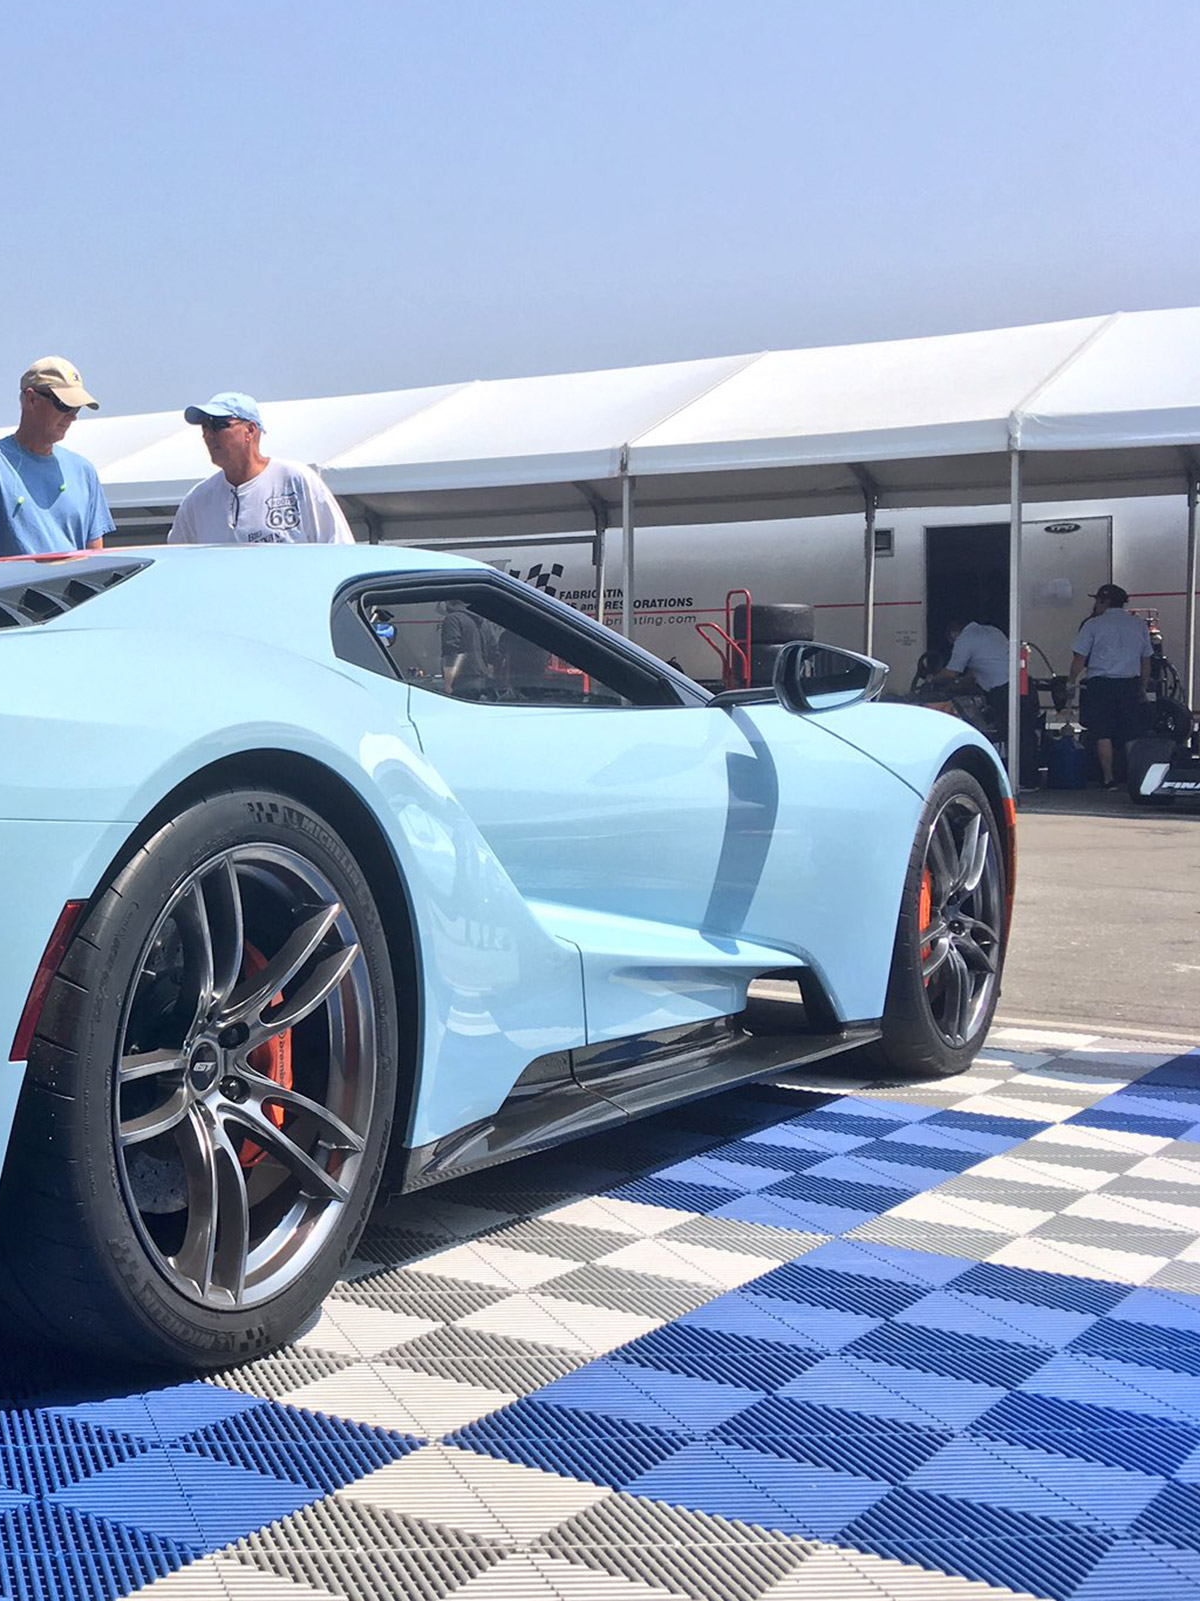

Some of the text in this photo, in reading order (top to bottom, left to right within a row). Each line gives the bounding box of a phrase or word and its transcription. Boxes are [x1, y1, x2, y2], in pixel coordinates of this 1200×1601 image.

[270, 508, 297, 526] 66
[559, 589, 624, 600] FABRICTIN
[604, 598, 693, 610] RESORATIONS
[603, 615, 696, 627] briting.com
[301, 816, 359, 886] MICHELIN
[193, 1062, 216, 1072] GT
